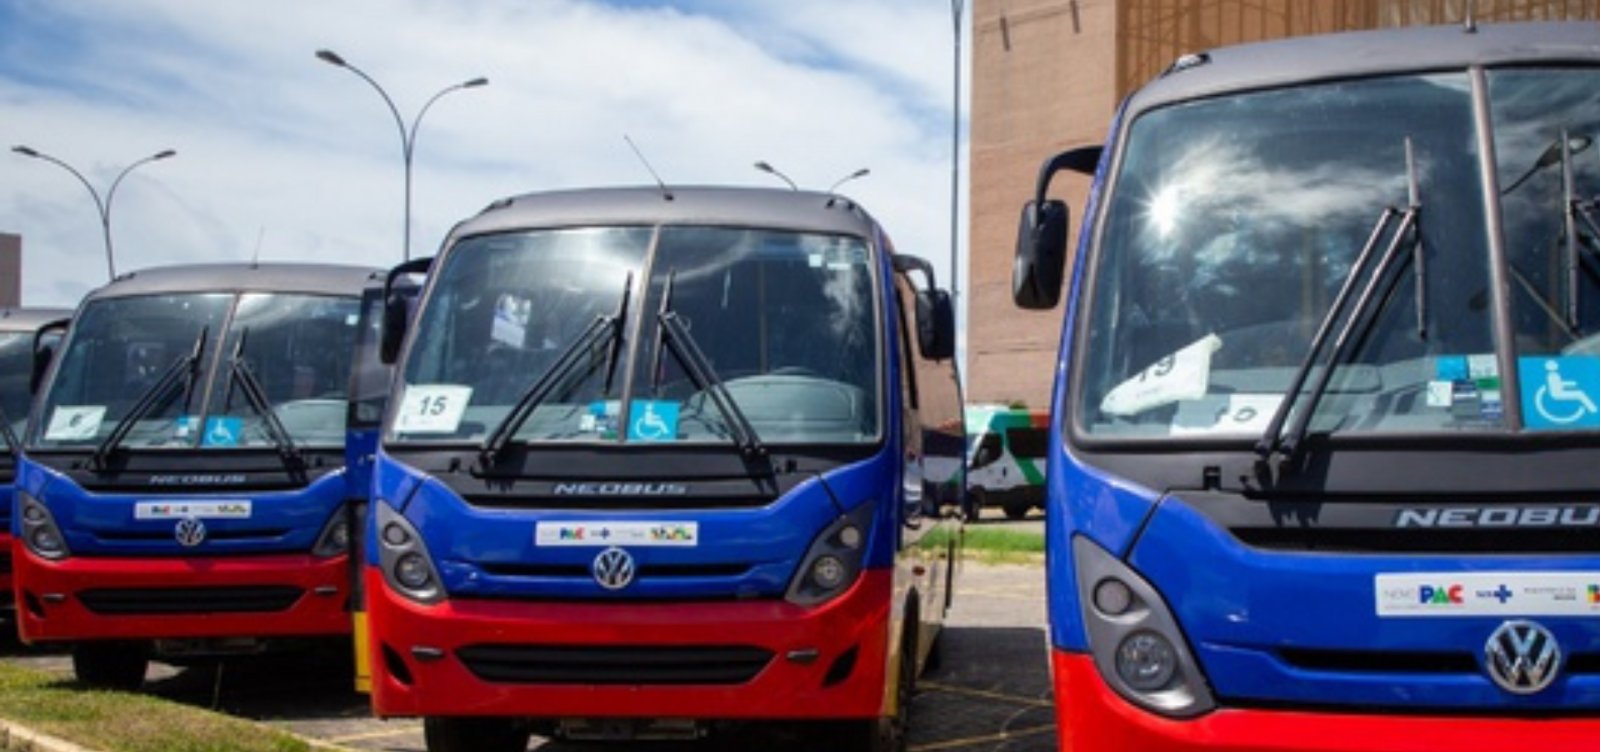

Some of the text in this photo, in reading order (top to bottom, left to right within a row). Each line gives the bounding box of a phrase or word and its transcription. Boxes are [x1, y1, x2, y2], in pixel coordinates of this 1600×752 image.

[420, 395, 448, 416] 15
[553, 483, 686, 496] NEOBUS
[1420, 584, 1464, 604] PAC
